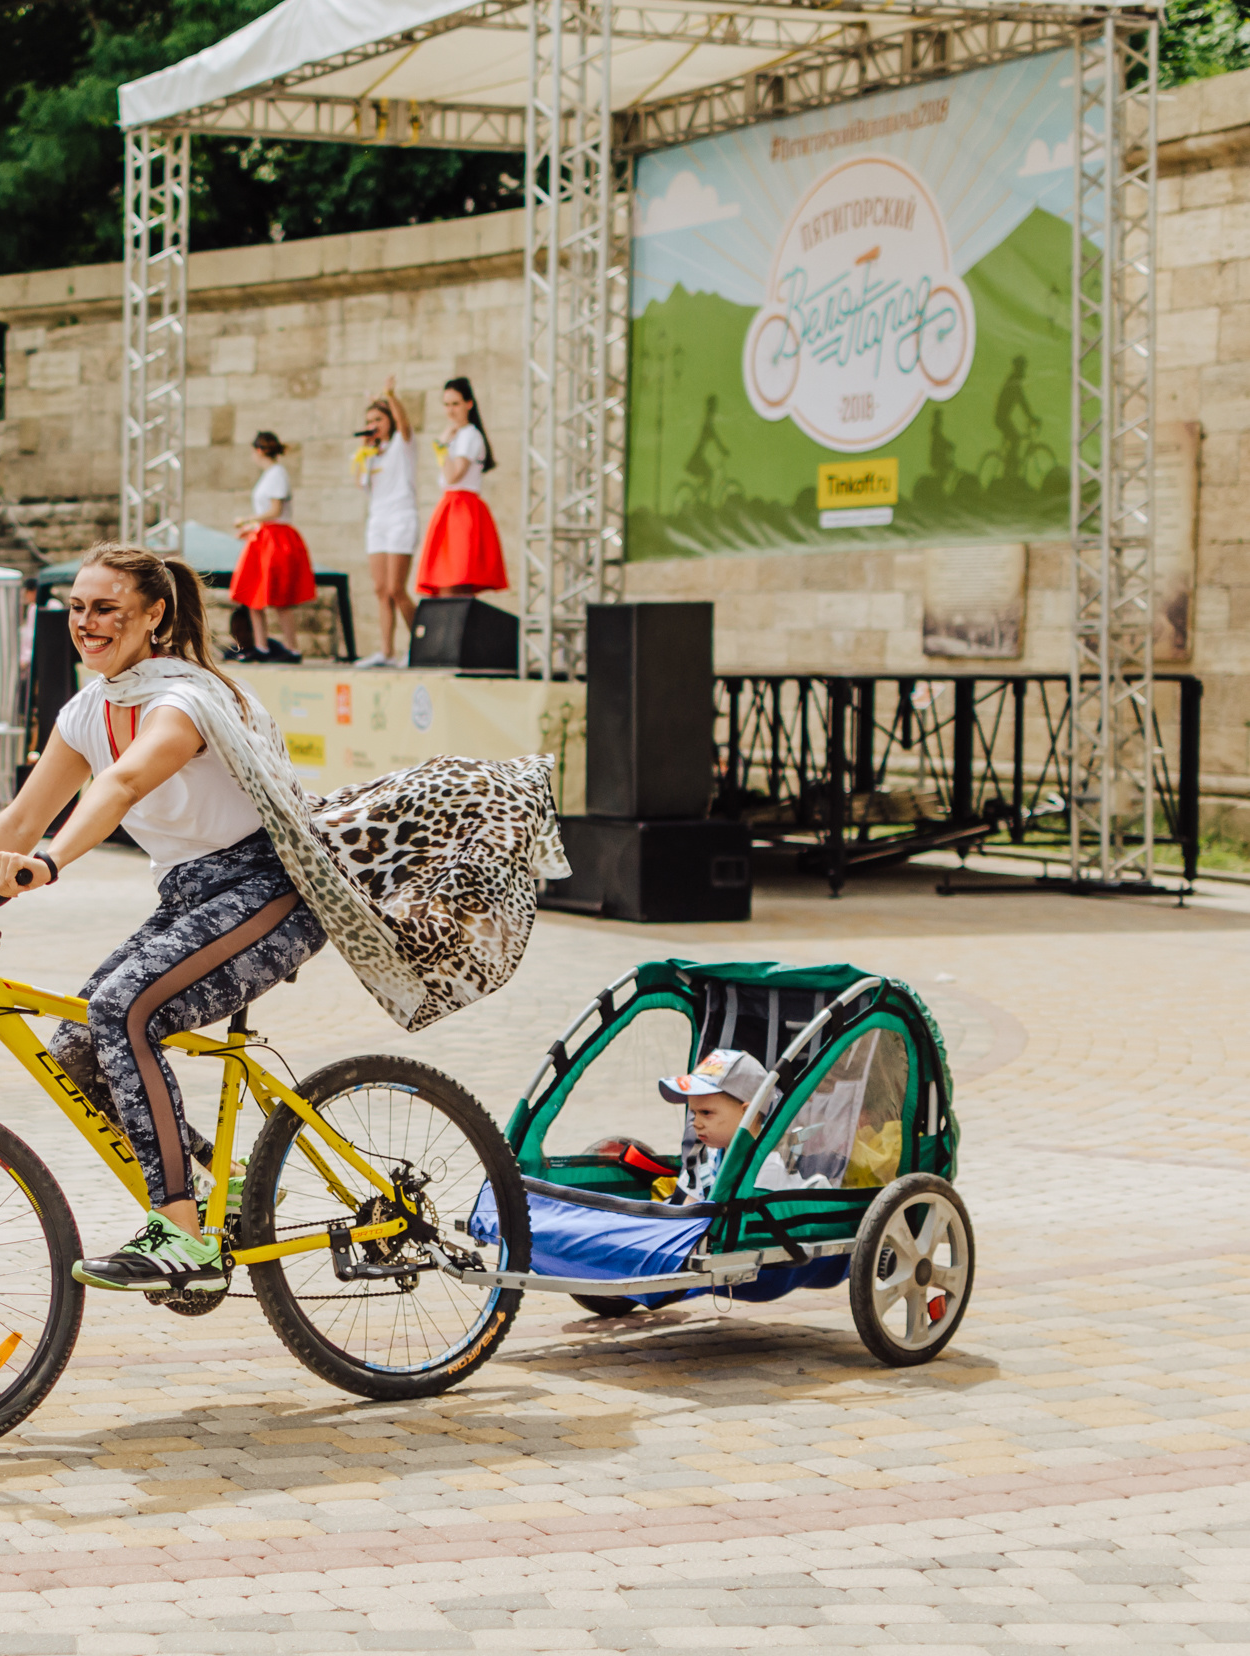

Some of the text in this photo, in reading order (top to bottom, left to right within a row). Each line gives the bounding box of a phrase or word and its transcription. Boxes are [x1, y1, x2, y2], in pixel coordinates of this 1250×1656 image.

[800, 194, 917, 252] ПЯТИГОРСКИЙ
[825, 471, 892, 496] Tinkoff.ru
[35, 1050, 136, 1164] CORTO
[352, 1228, 384, 1239] ORTO
[446, 1330, 494, 1375] BARON
